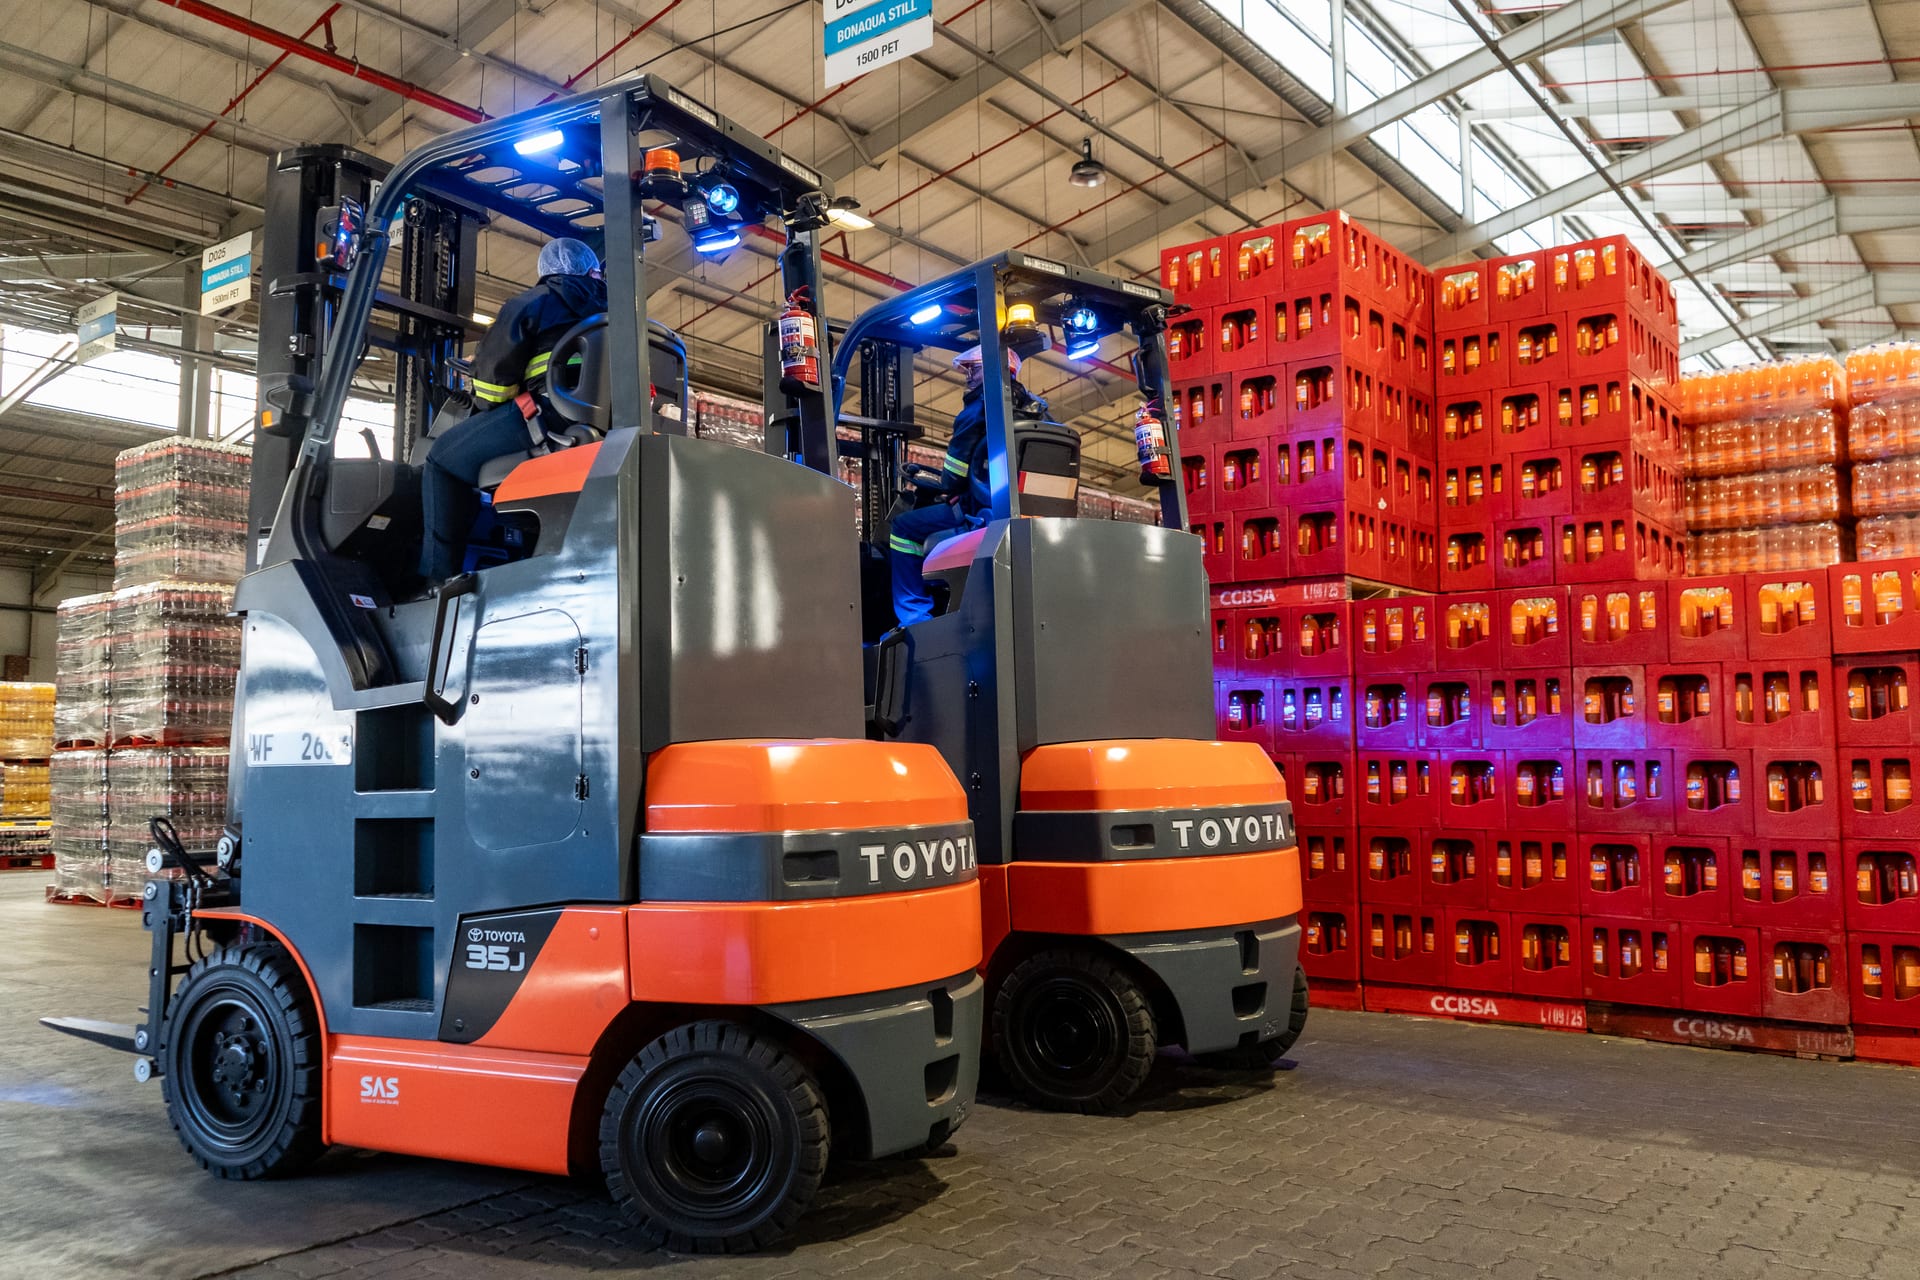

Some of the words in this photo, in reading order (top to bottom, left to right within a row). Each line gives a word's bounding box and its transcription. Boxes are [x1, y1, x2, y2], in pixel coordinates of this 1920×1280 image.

[836, 12, 887, 44] BONAQUA
[888, 0, 918, 21] STILL
[856, 48, 880, 67] 1500
[881, 40, 900, 57] PET
[229, 287, 240, 299] PET
[1220, 588, 1276, 606] CCBSA
[250, 733, 274, 761] WF
[1171, 814, 1286, 849] TOYOTA
[859, 836, 977, 883] TOYOTA
[484, 930, 526, 943] TOYOTA
[465, 944, 526, 972] 35J
[1430, 995, 1499, 1017] CCBSA
[1672, 1017, 1755, 1043] CCBSA
[360, 1075, 399, 1099] SAS
